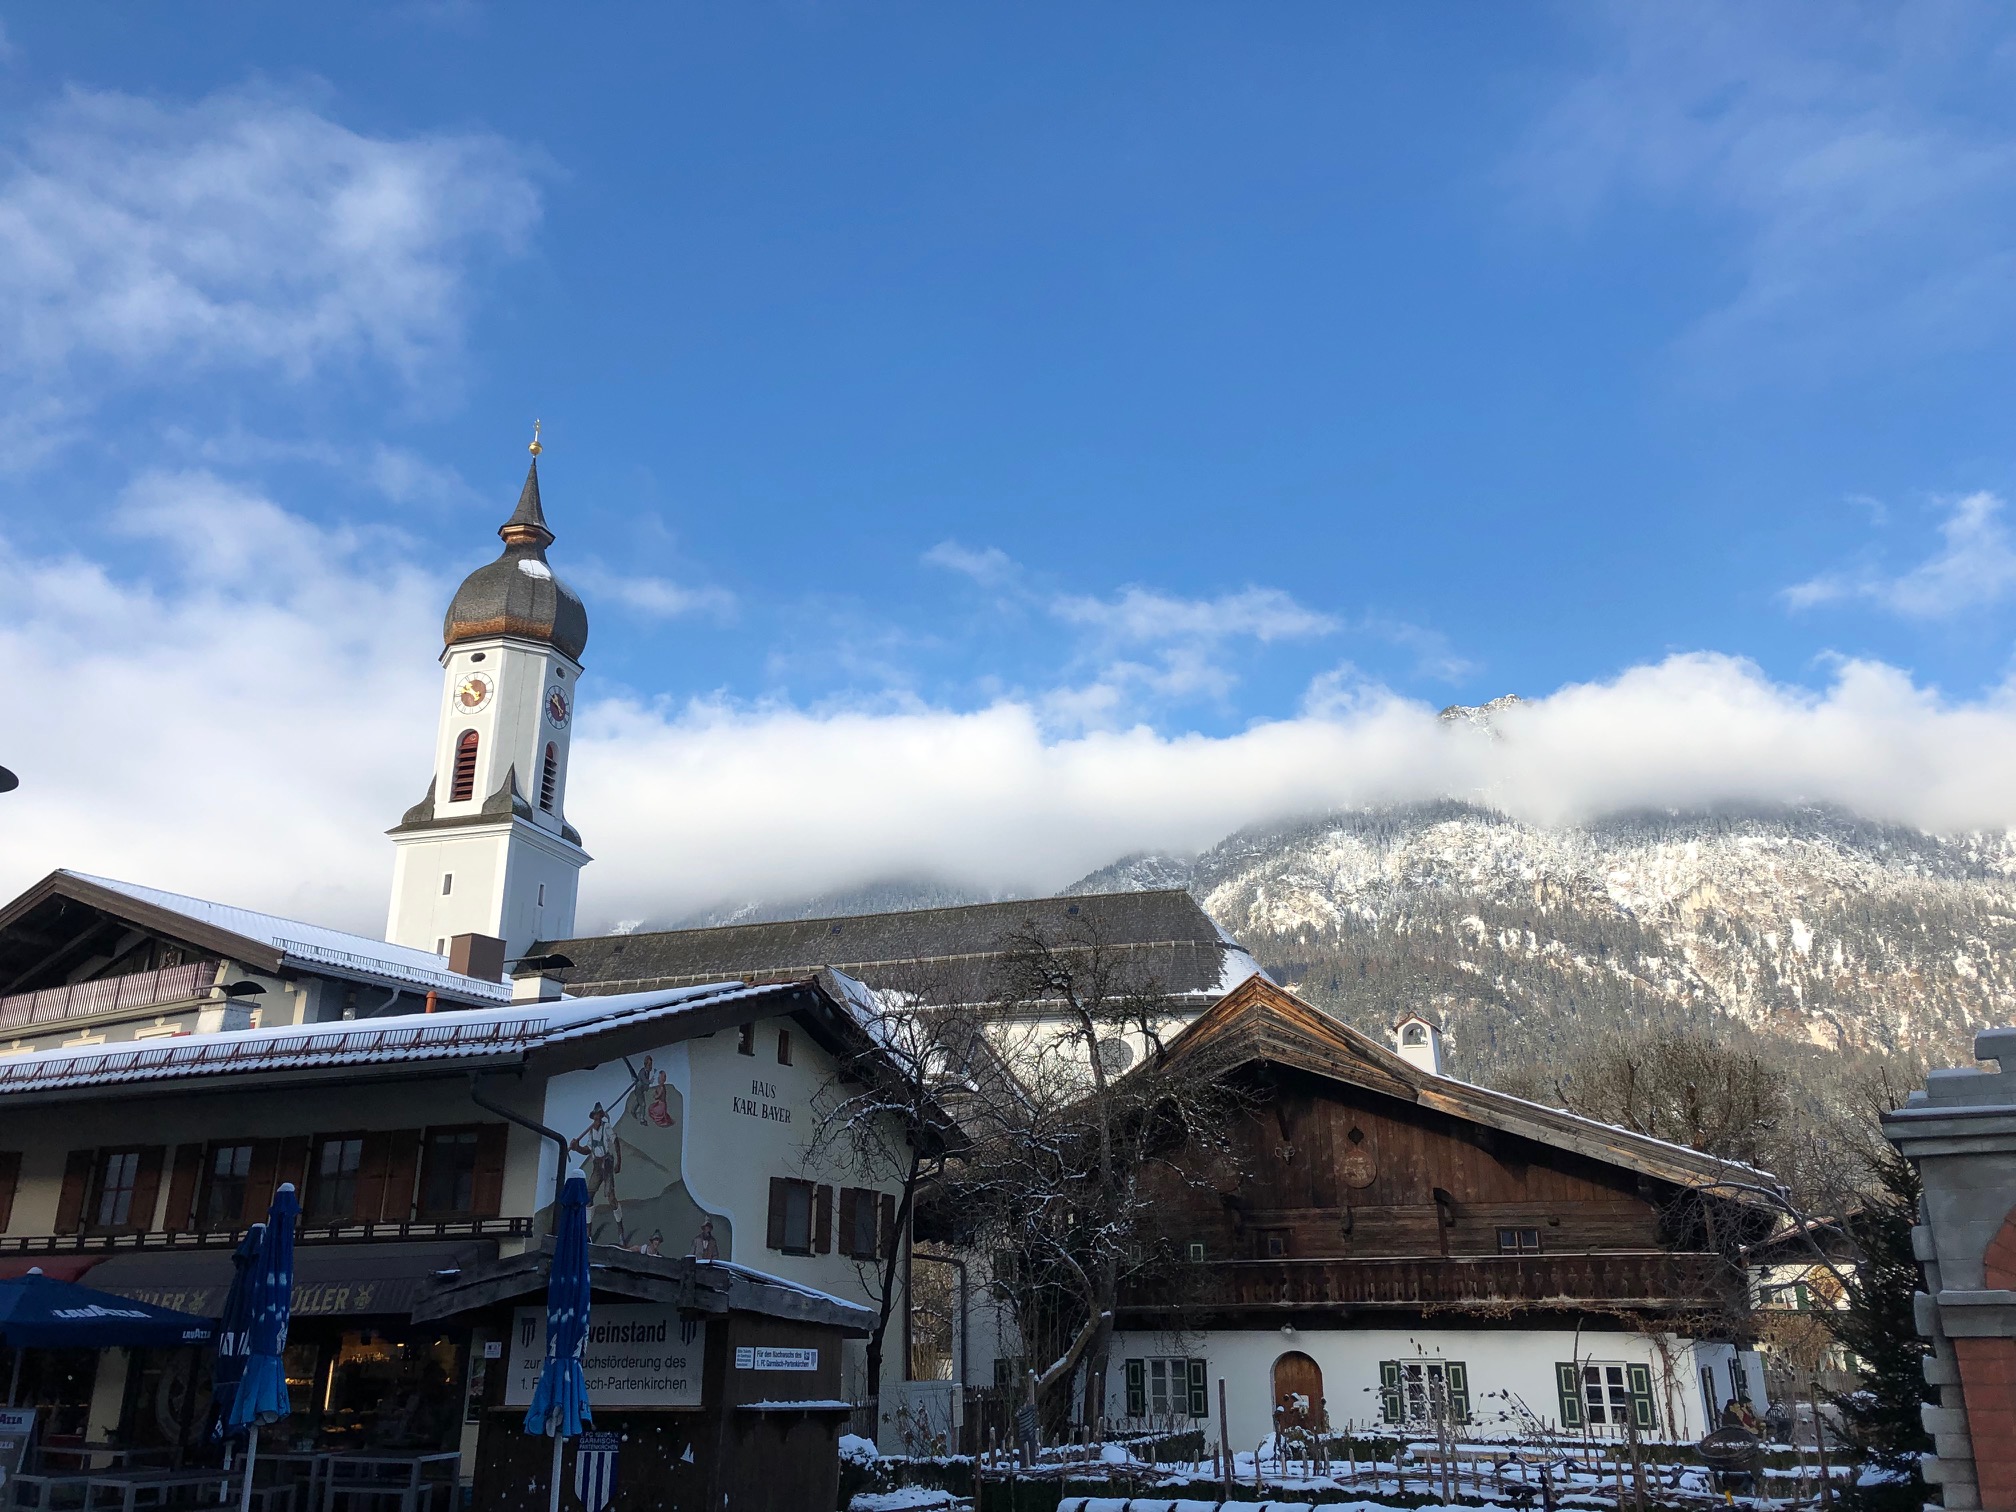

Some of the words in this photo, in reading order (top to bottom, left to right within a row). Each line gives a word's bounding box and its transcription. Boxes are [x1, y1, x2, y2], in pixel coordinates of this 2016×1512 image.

[751, 1079, 777, 1099] HAUS
[732, 1096, 758, 1117] KARL
[761, 1103, 791, 1124] BAYER
[290, 1286, 350, 1312] ÜLLER
[51, 1304, 153, 1319] LAVAZZA
[182, 1327, 212, 1339] LAVAZZA
[756, 1350, 764, 1358] Für
[764, 1350, 772, 1358] den
[523, 1359, 541, 1369] zur
[581, 1355, 661, 1372] uchsförderung
[665, 1355, 687, 1368] des
[760, 1359, 766, 1367] FC
[766, 1359, 809, 1368] Garmisch-Partenkirchen
[521, 1377, 528, 1390] 1.
[531, 1377, 540, 1390] F
[584, 1376, 687, 1390] sch-Partenkirchen
